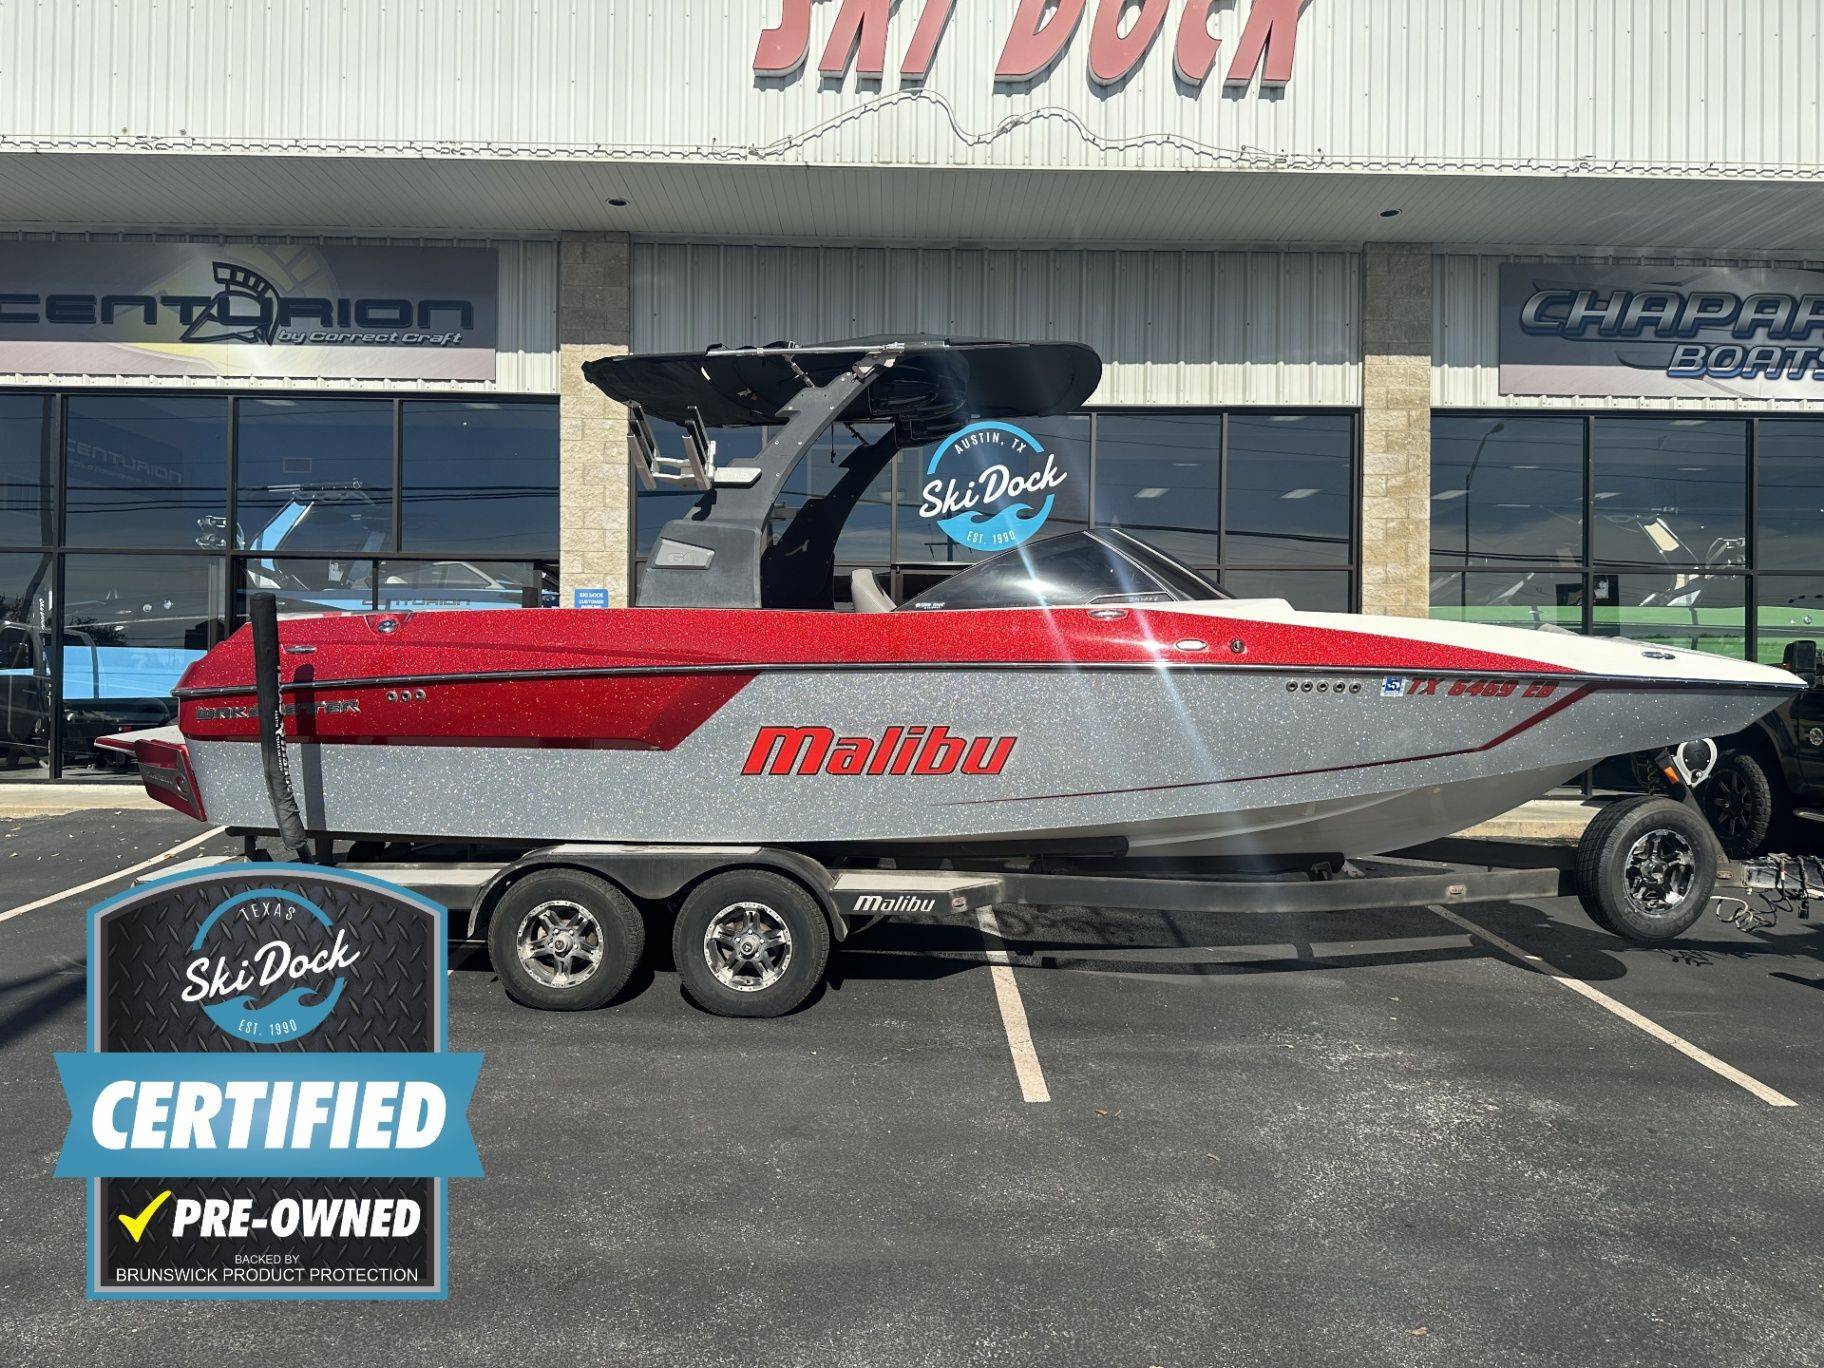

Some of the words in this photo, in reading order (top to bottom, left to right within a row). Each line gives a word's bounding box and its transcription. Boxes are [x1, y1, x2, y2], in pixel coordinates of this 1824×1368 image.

[278, 330, 305, 344] by
[309, 331, 398, 344] Correct
[401, 332, 462, 347] Craft
[953, 432, 1004, 454] AUSTIN,
[1011, 438, 1027, 453] TX
[919, 479, 979, 517] Ski
[978, 454, 1067, 504] Dock
[966, 530, 987, 544] EST.
[992, 529, 1016, 544] 1990
[1407, 677, 1444, 695] TX
[1448, 679, 1518, 697] 6469
[740, 725, 1018, 776] Malibu
[853, 895, 935, 912] Malibu
